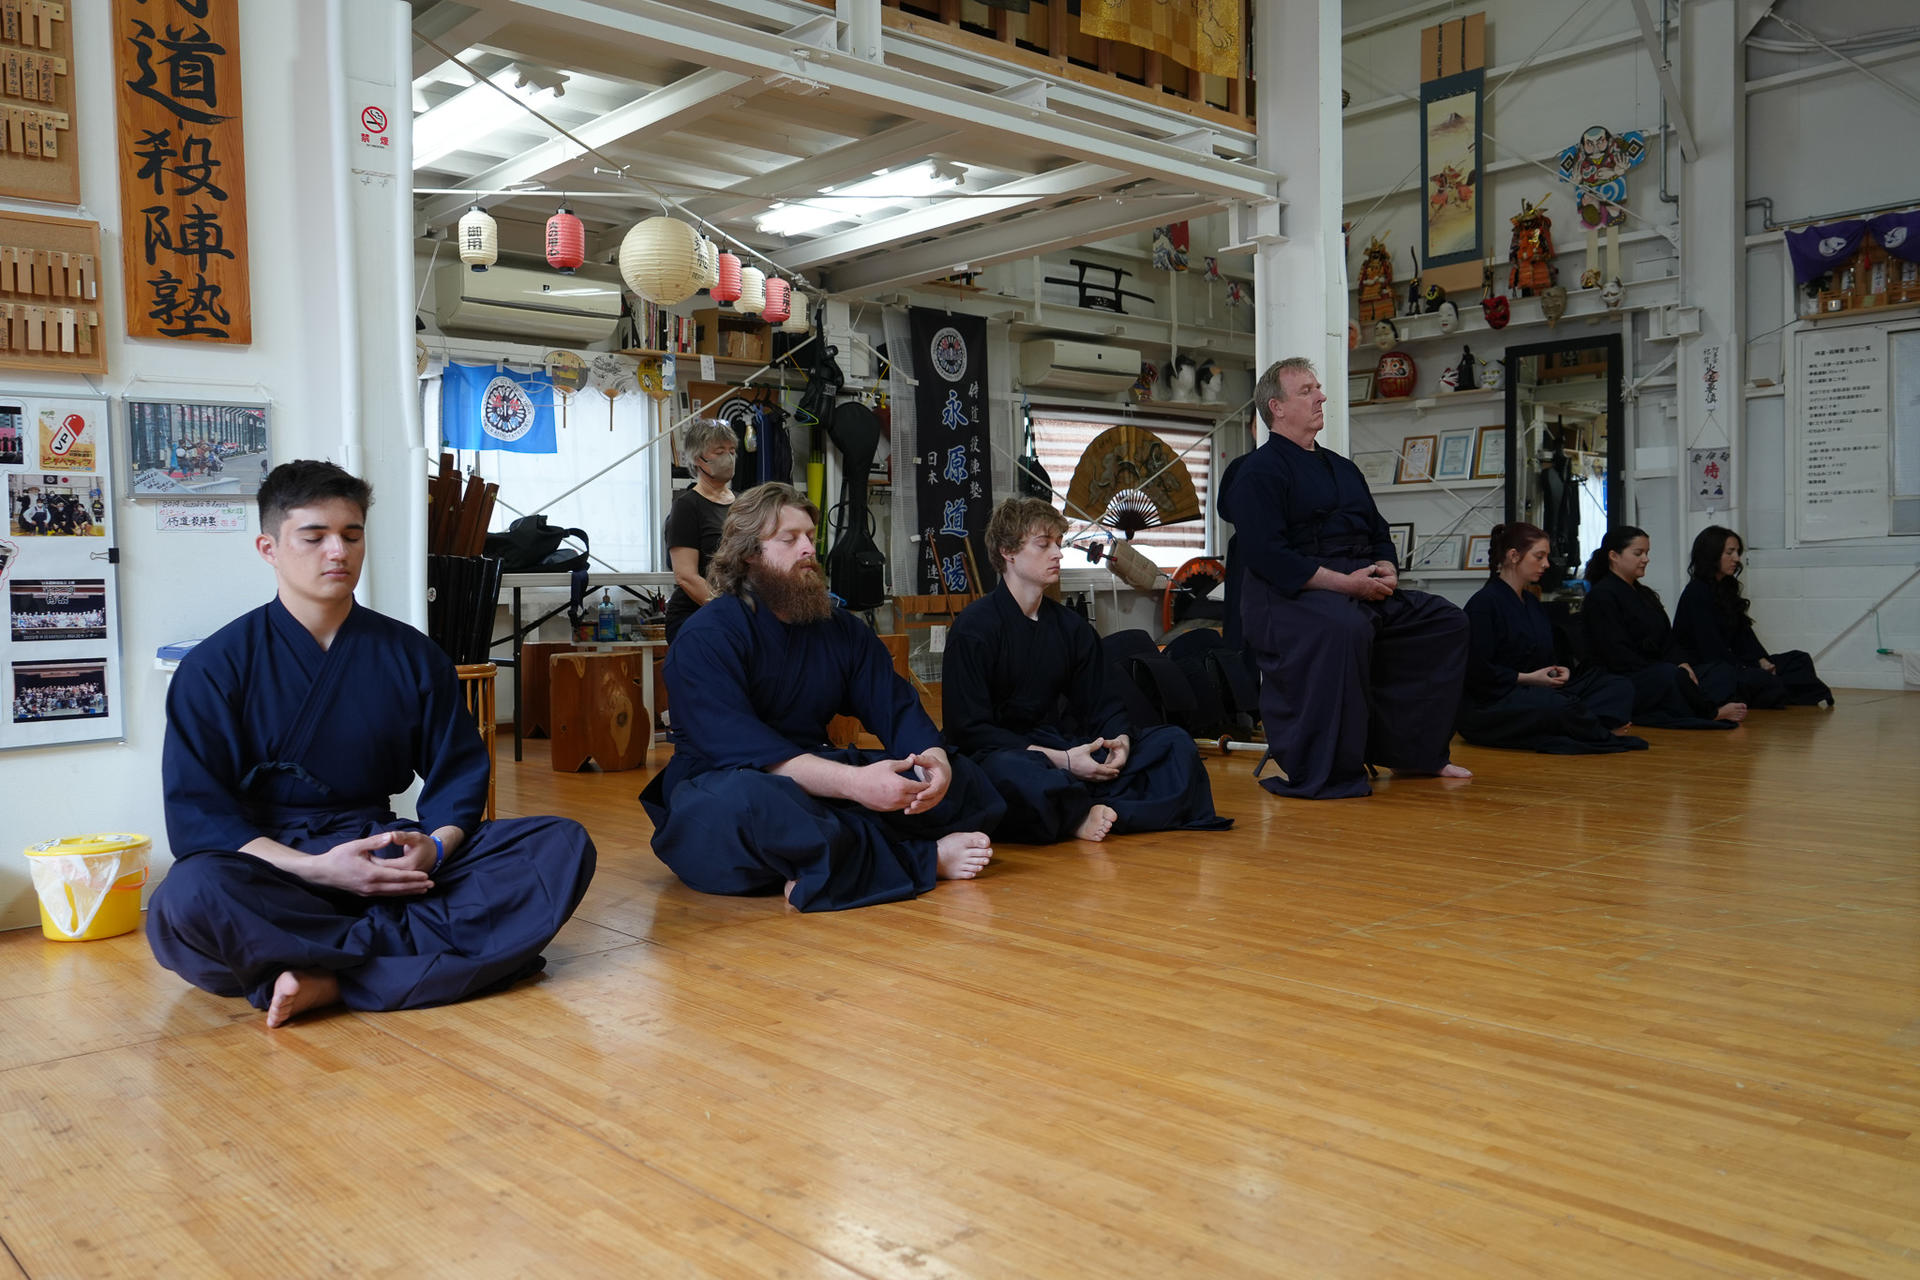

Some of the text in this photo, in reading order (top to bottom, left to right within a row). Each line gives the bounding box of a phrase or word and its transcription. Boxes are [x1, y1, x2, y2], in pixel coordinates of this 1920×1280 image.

[361, 133, 389, 146] 禁煙
[126, 0, 239, 338] 道殺陣塾
[53, 432, 69, 451] VP
[927, 451, 939, 485] 日本
[941, 389, 969, 593] 永原道場
